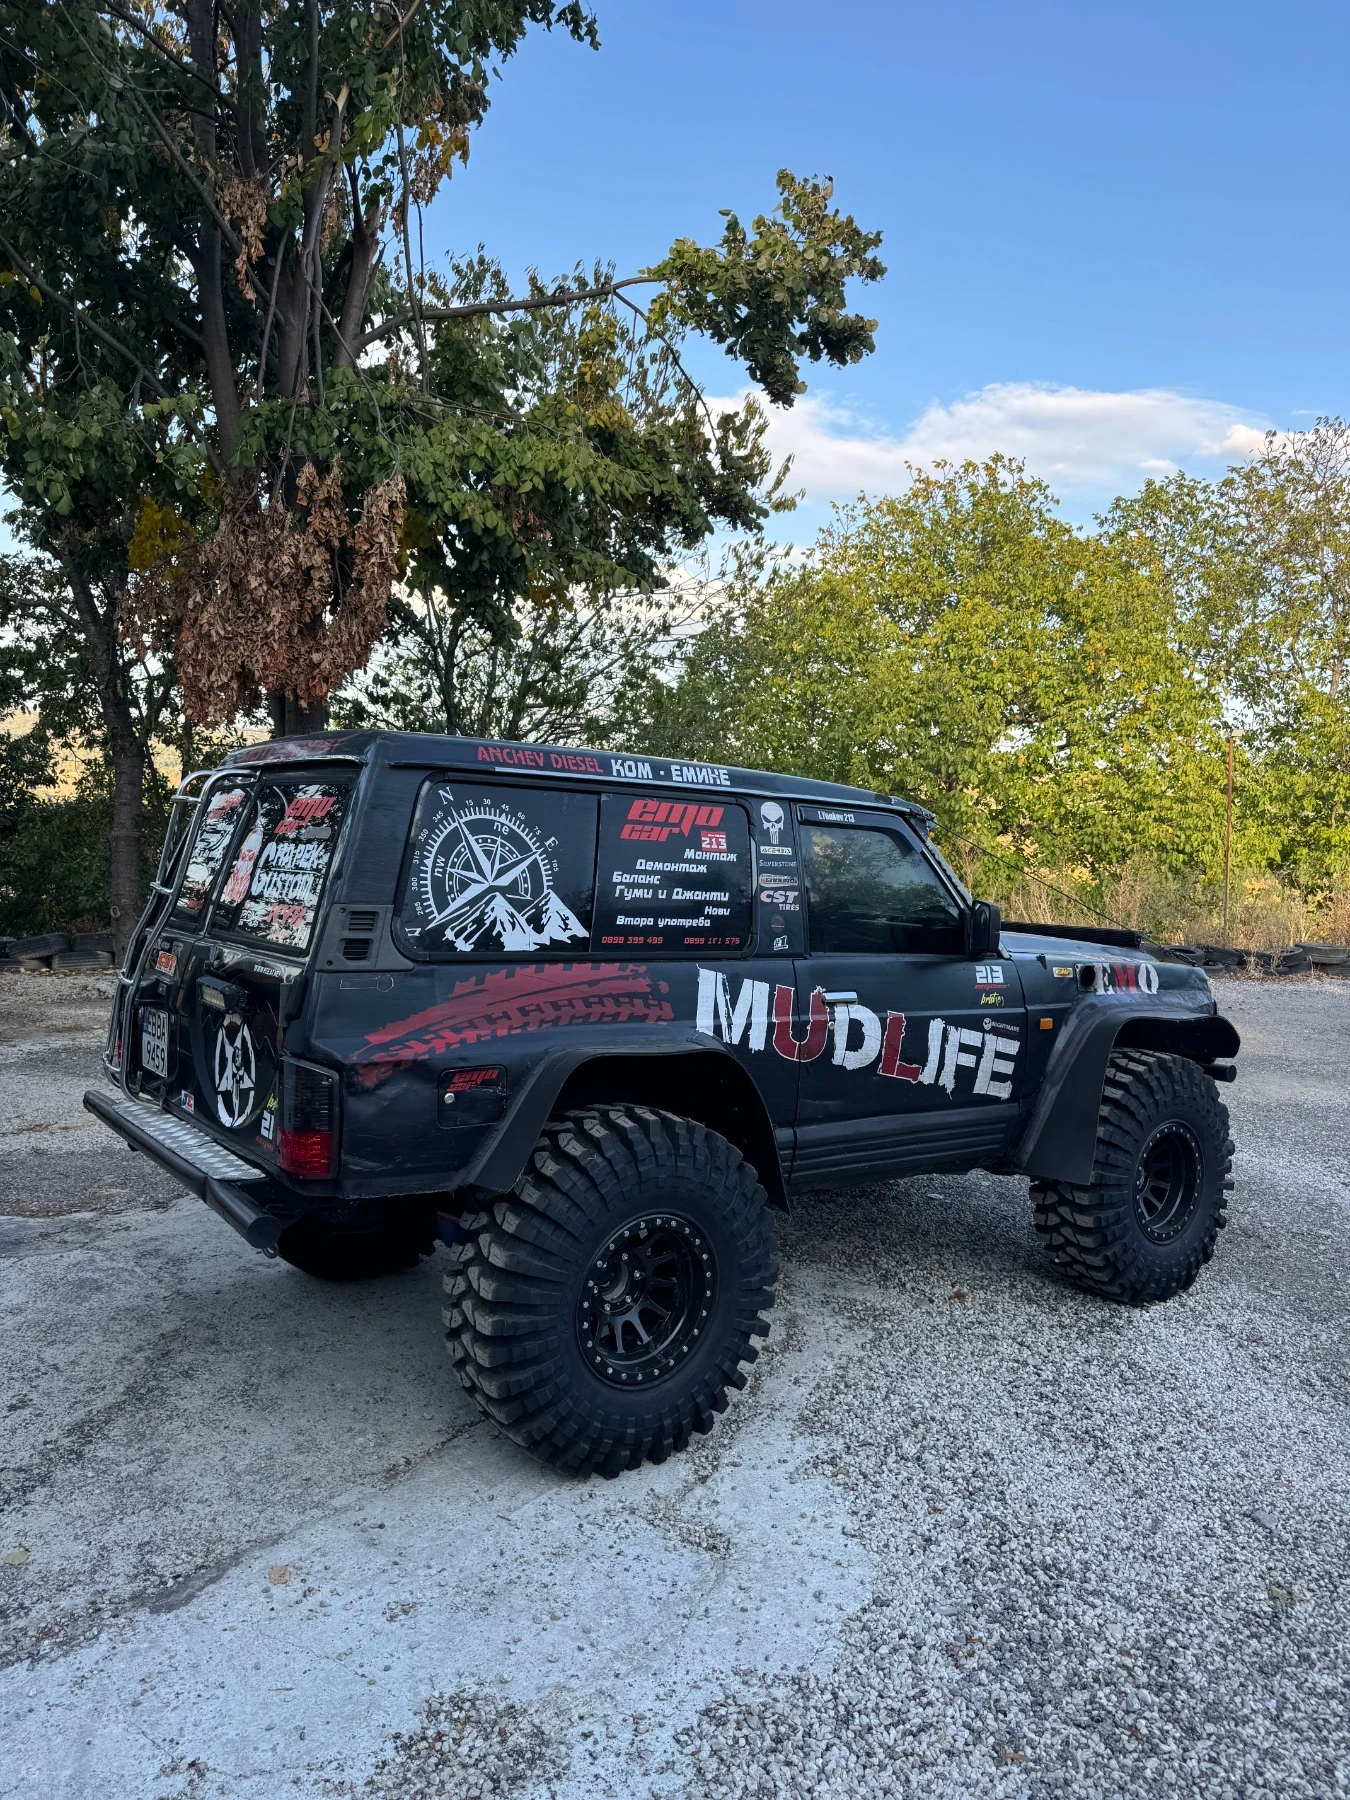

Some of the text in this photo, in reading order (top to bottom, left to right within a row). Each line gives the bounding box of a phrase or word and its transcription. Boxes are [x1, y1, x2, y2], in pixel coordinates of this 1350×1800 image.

[477, 745, 604, 773] ANCHEV DIESEL
[438, 786, 454, 805] N
[501, 803, 510, 812] 45
[432, 810, 445, 823] 345
[517, 811, 526, 820] 60
[627, 799, 725, 837] emo
[493, 821, 510, 835] ne
[533, 825, 542, 836] 75
[619, 823, 681, 842] car
[543, 836, 559, 851] E
[701, 836, 727, 850] 213
[683, 848, 737, 862] Монтаж
[433, 854, 446, 877] nw
[551, 859, 560, 872] 105
[635, 858, 707, 874] Демонтаж
[411, 877, 419, 891] 300
[612, 871, 661, 885] Баланс
[614, 885, 730, 902] Гуми и Джанти
[760, 890, 799, 904] CST
[413, 901, 424, 916] 285
[704, 905, 731, 916] Нови
[778, 903, 800, 911] TIRES
[615, 915, 711, 929] Втора употреба
[601, 936, 664, 945] 0898 399 499
[683, 937, 705, 945] 0899
[724, 937, 740, 945] 575
[974, 965, 1004, 984] 213
[146, 1039, 166, 1074] 9459
